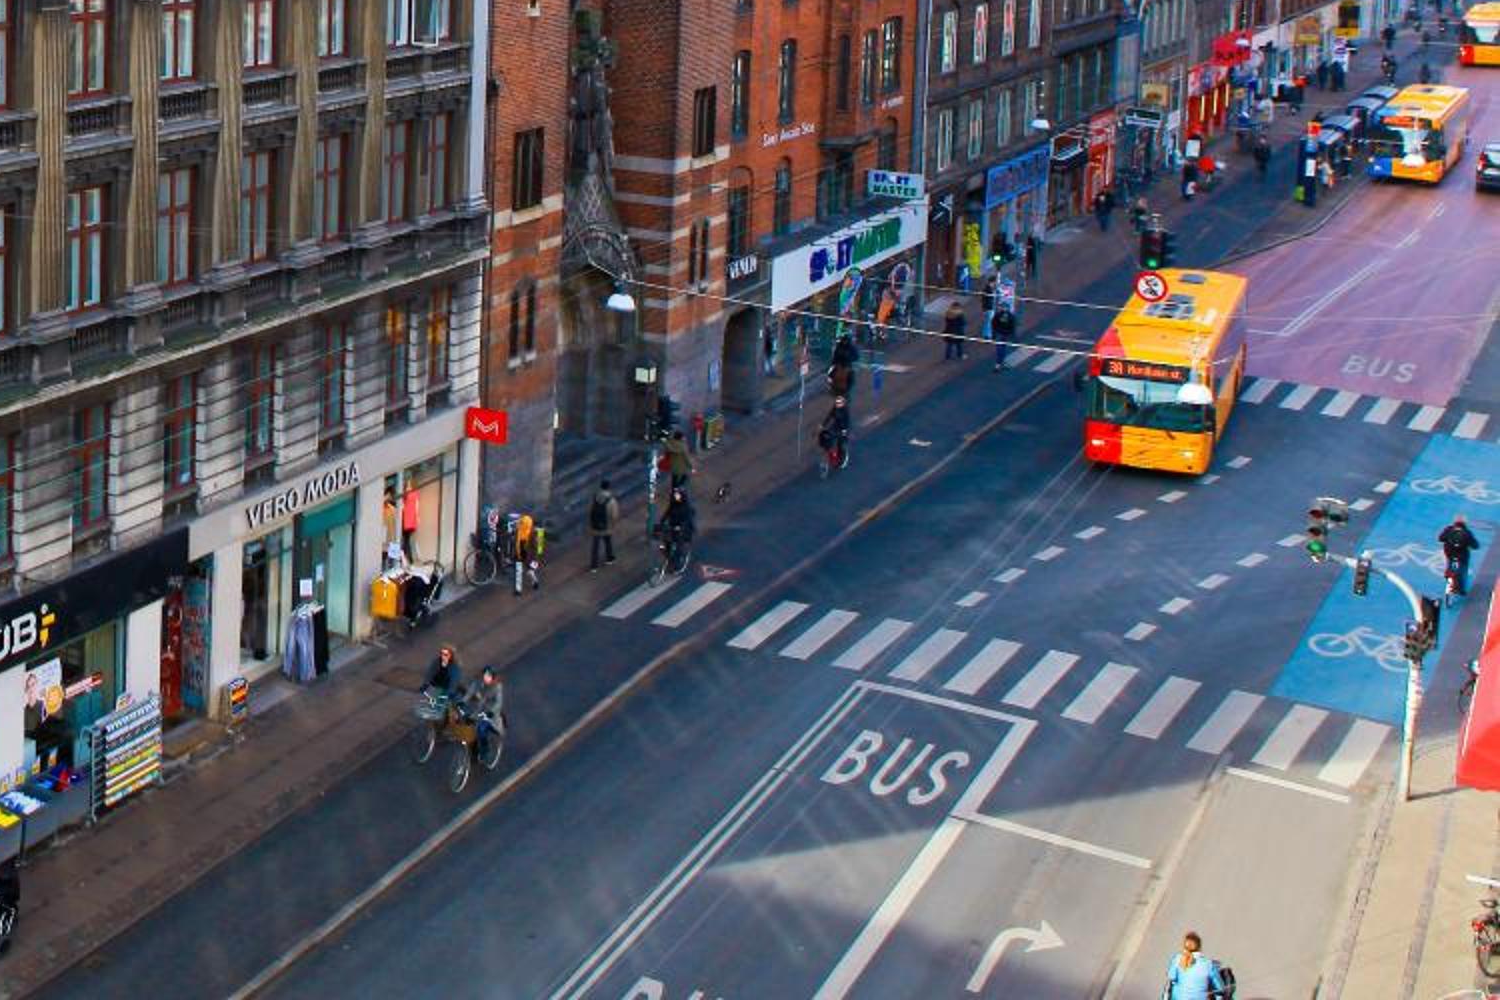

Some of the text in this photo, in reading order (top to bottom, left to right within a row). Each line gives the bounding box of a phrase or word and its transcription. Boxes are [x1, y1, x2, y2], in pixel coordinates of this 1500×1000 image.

[1341, 354, 1418, 384] BUS
[245, 461, 360, 529] VERO MODA
[820, 730, 970, 806] BUS
